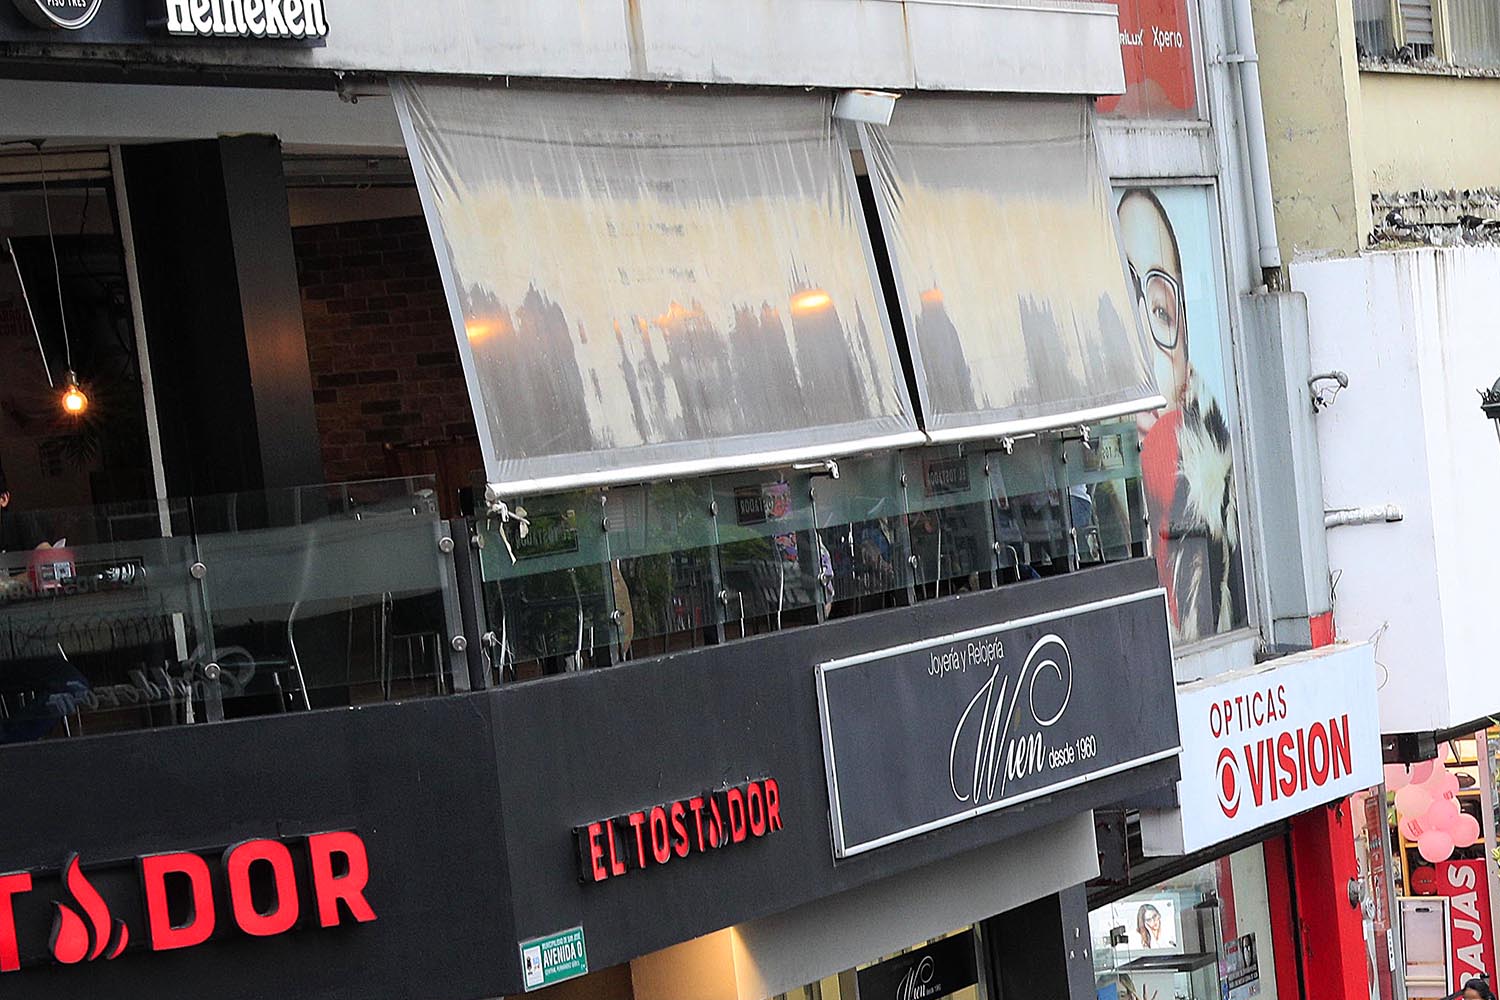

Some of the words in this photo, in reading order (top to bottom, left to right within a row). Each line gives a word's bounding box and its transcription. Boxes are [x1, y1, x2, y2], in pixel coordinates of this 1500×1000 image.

[167, 0, 328, 36] Heineken
[928, 647, 960, 678] Joyería
[959, 651, 966, 672] y
[967, 637, 1004, 667] Relojería
[950, 633, 1072, 804] Wien
[1210, 684, 1287, 738] OPTICAS
[1049, 742, 1075, 769] desde
[1076, 734, 1097, 760] 1960
[1243, 714, 1353, 808] VISION
[588, 819, 626, 882] EL
[629, 778, 784, 868] TOSTADOR
[543, 943, 576, 968] AVENIDA
